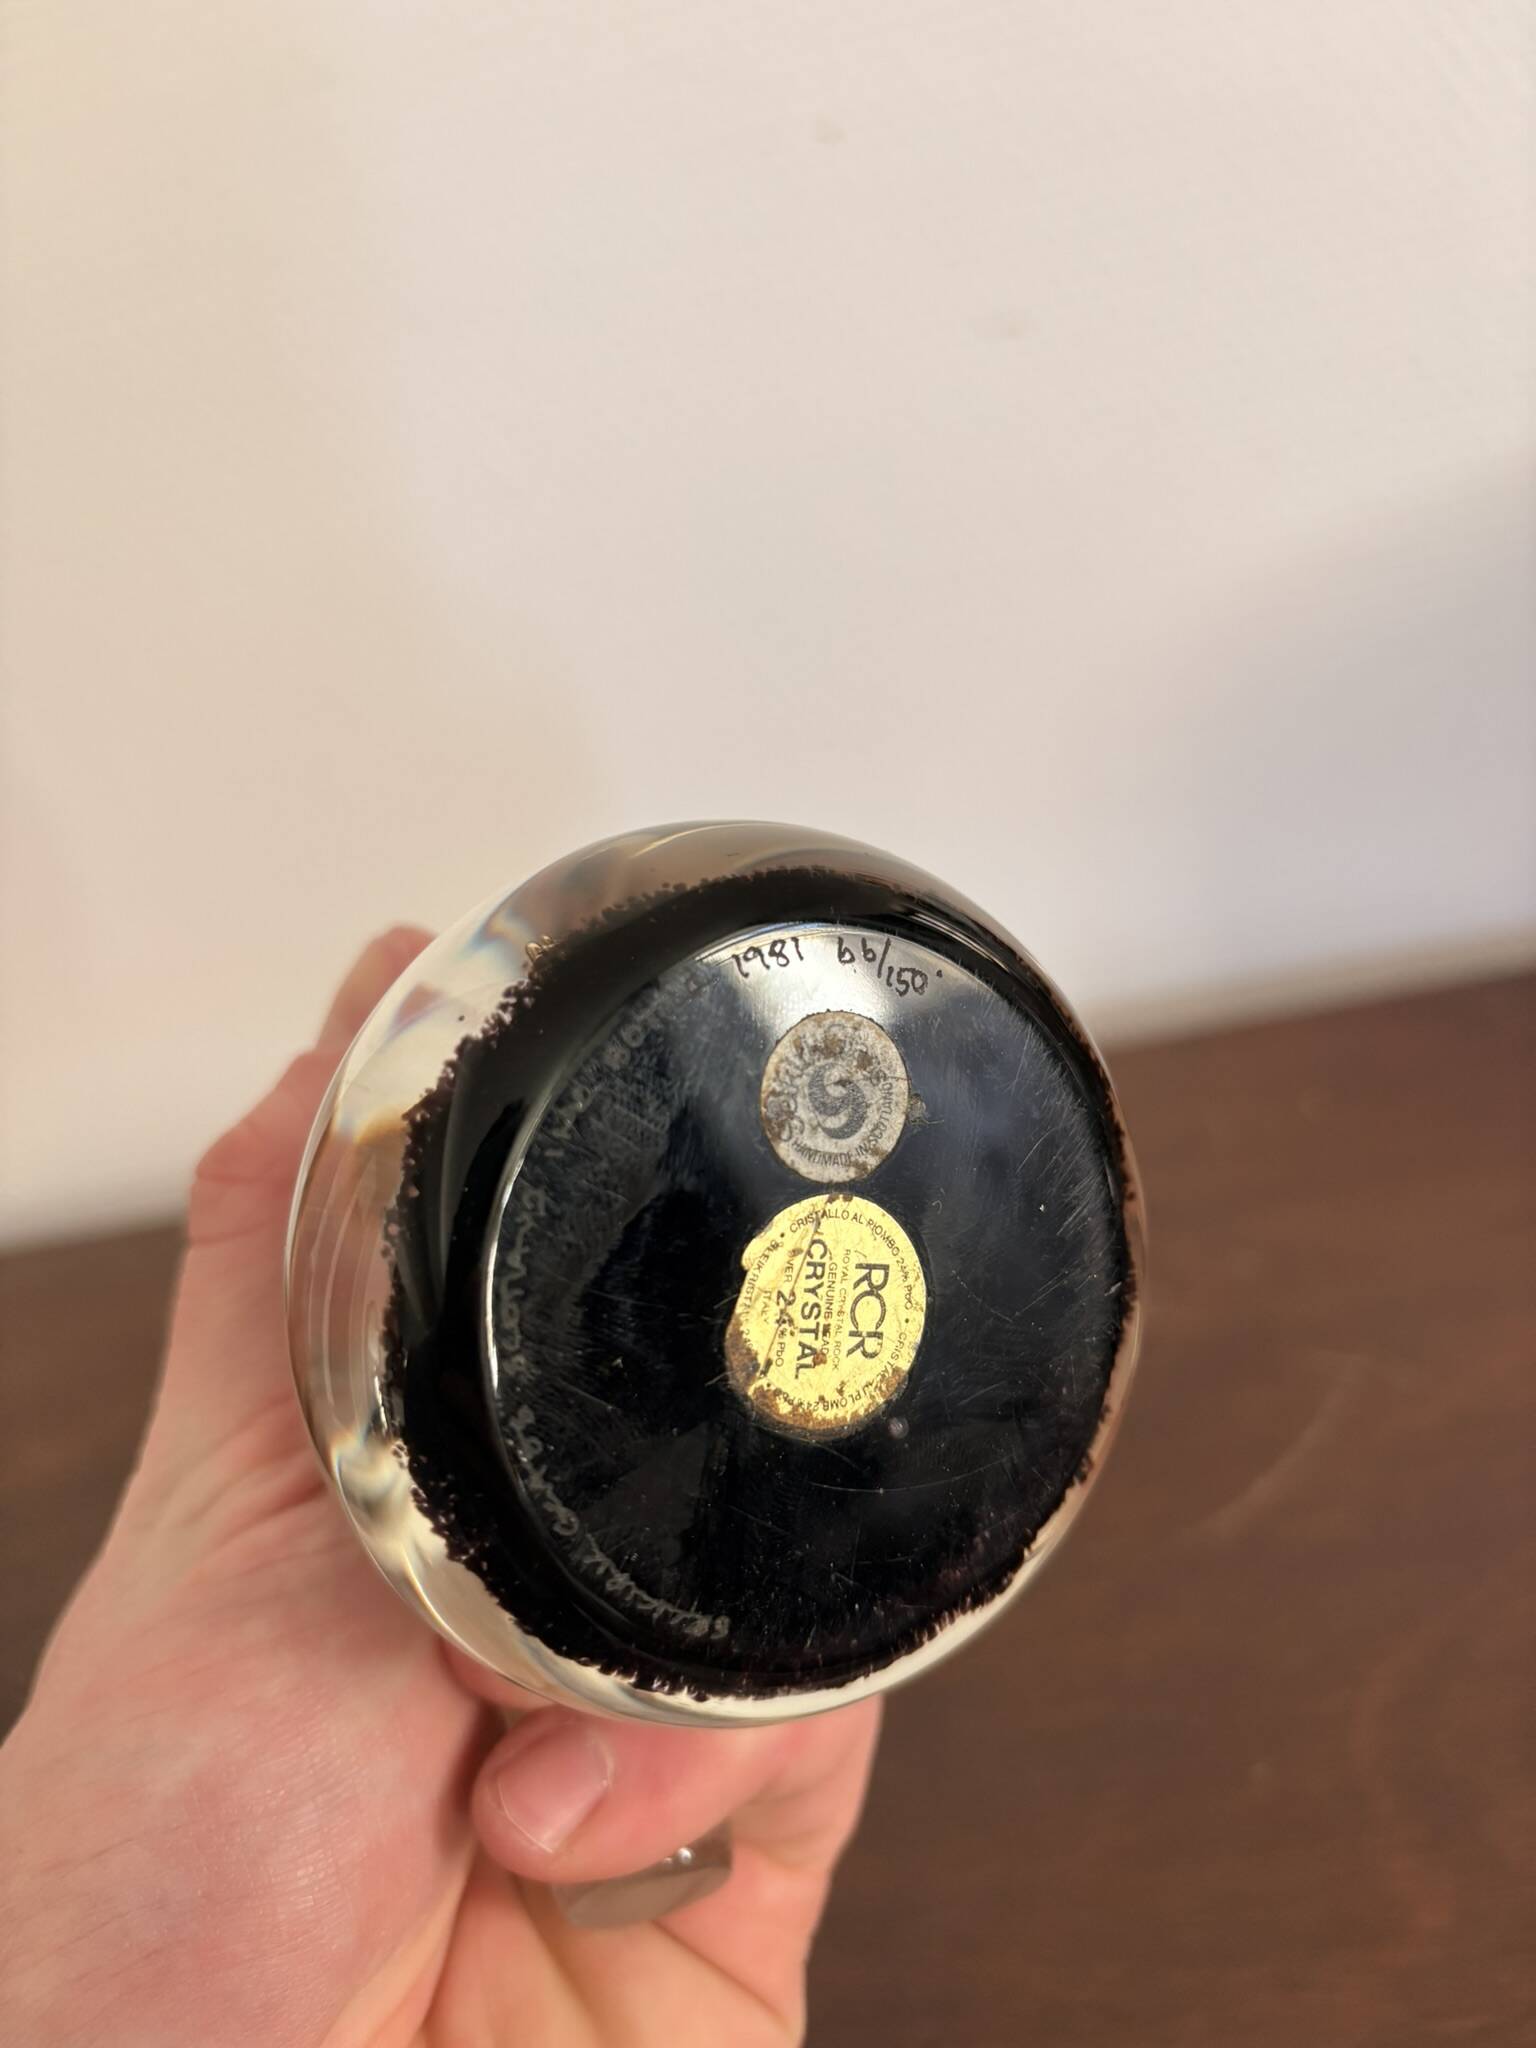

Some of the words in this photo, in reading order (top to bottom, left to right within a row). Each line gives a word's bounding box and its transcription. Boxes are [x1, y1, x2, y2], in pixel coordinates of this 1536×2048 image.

[731, 936, 803, 978] 1981
[851, 1213, 865, 1226] AL
[867, 1219, 900, 1257] PIOMBO
[839, 1249, 850, 1283] ROYAL
[759, 1290, 772, 1324] ITALY
[795, 1239, 828, 1380] CRYSTAL
[824, 1262, 837, 1321] GENUINE
[846, 1263, 890, 1359] RCR
[832, 1340, 843, 1371] ROCK
